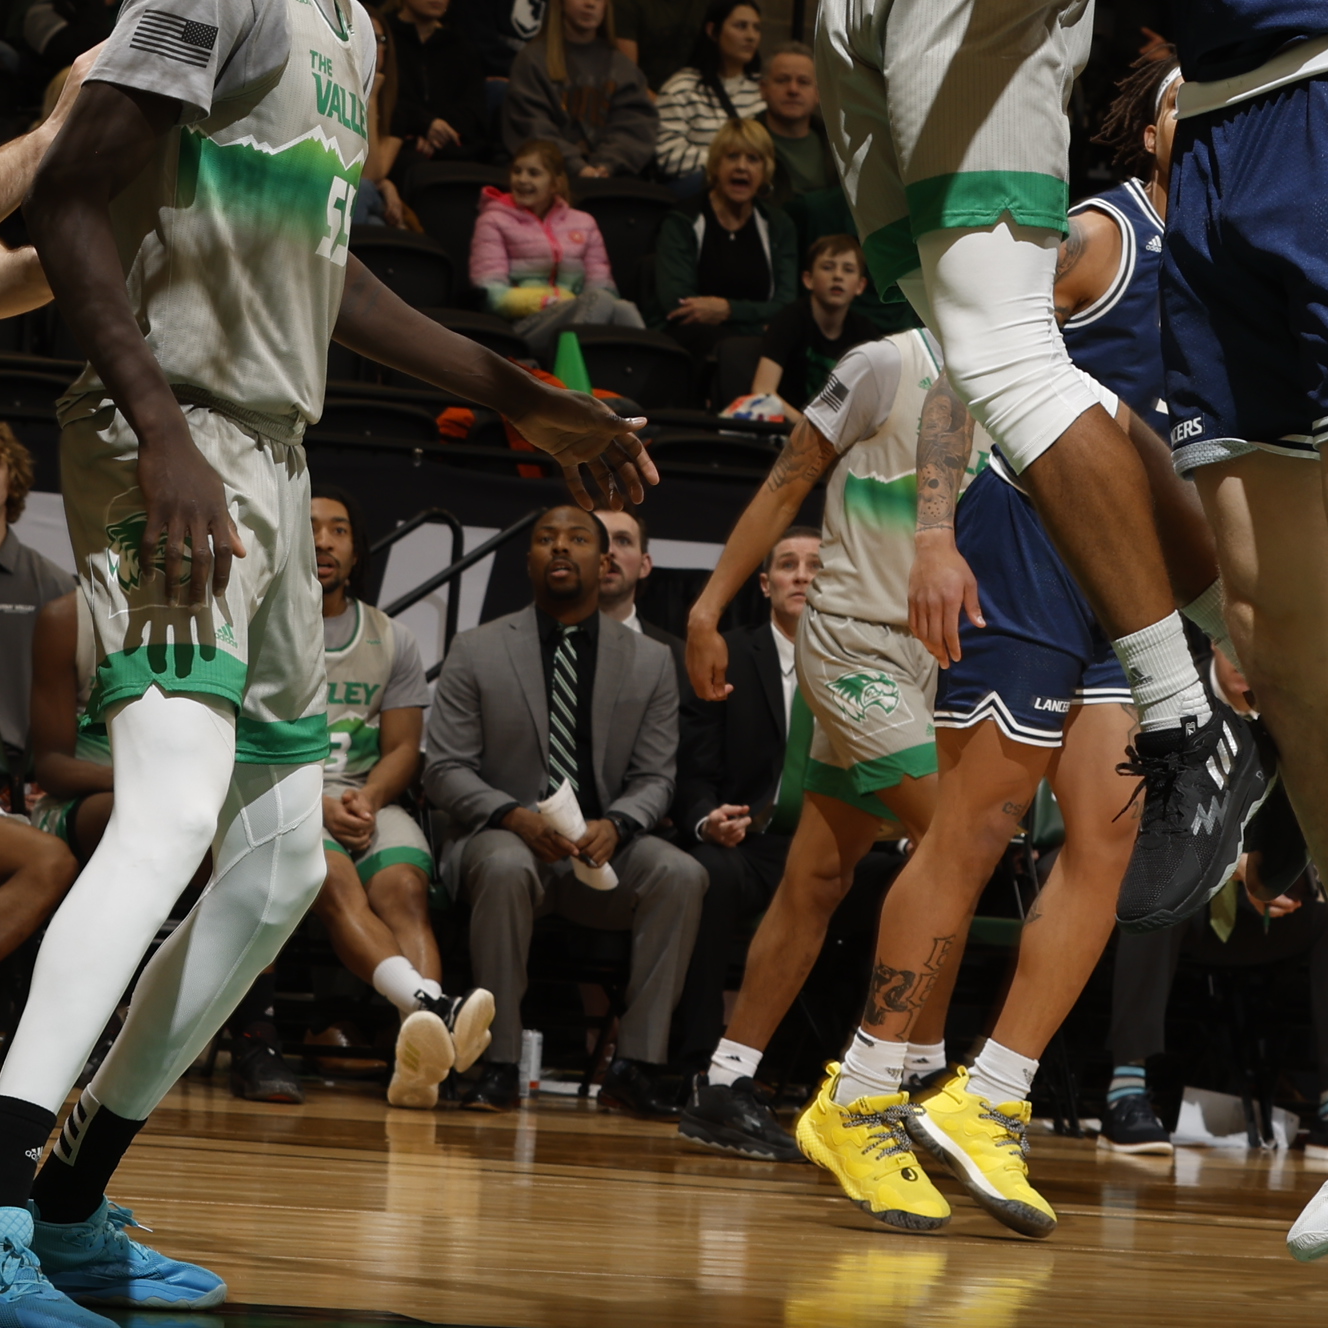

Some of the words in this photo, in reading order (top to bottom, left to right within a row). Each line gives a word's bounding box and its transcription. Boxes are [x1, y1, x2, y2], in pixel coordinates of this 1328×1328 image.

[309, 49, 333, 77] THE
[312, 72, 367, 140] VALLE
[215, 632, 238, 649] adidas
[328, 682, 381, 705] LEY
